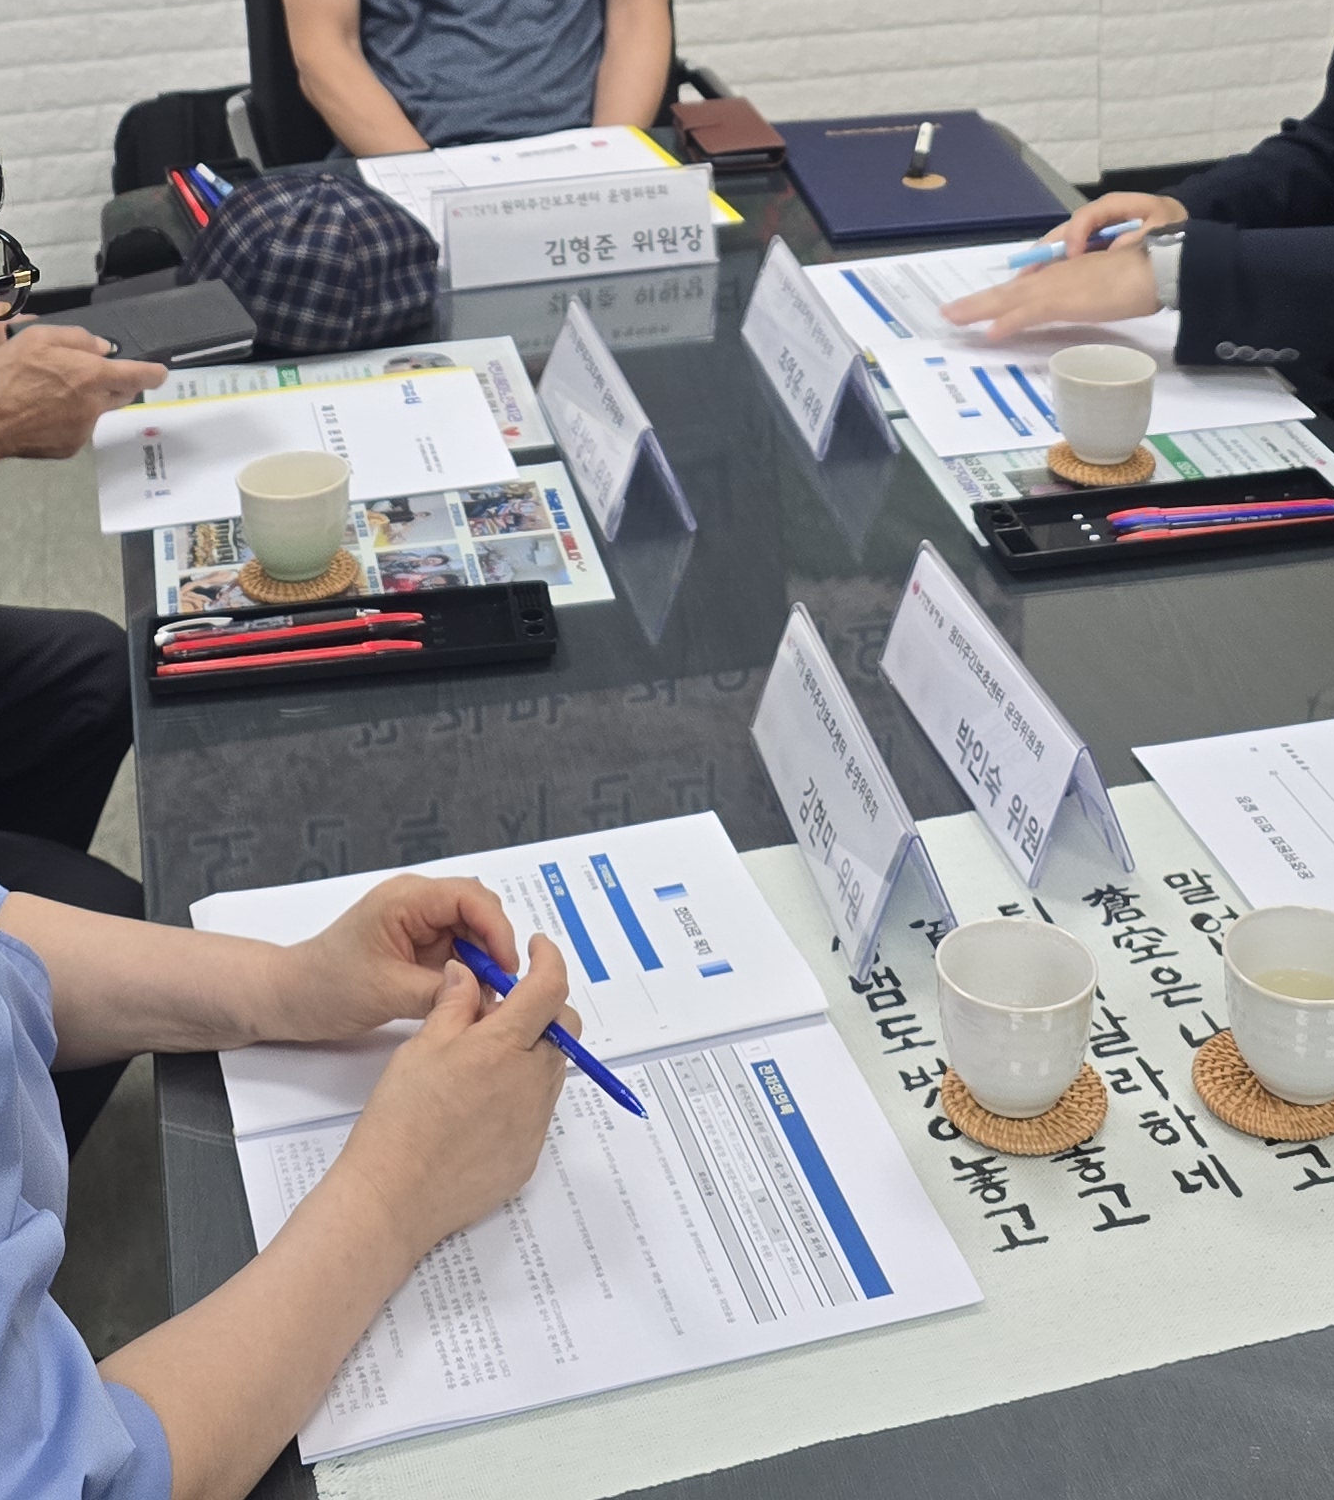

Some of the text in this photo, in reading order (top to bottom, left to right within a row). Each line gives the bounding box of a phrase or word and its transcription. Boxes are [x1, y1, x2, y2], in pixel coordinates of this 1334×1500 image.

[545, 223, 704, 266] 김형준 위원장
[949, 626, 1044, 761] 원미주간보호센터 운영위원회
[800, 777, 864, 932] 김현미 위원
[956, 718, 1001, 807] 박인숙
[1007, 795, 1043, 863] 위원
[673, 907, 702, 937] 회의자료
